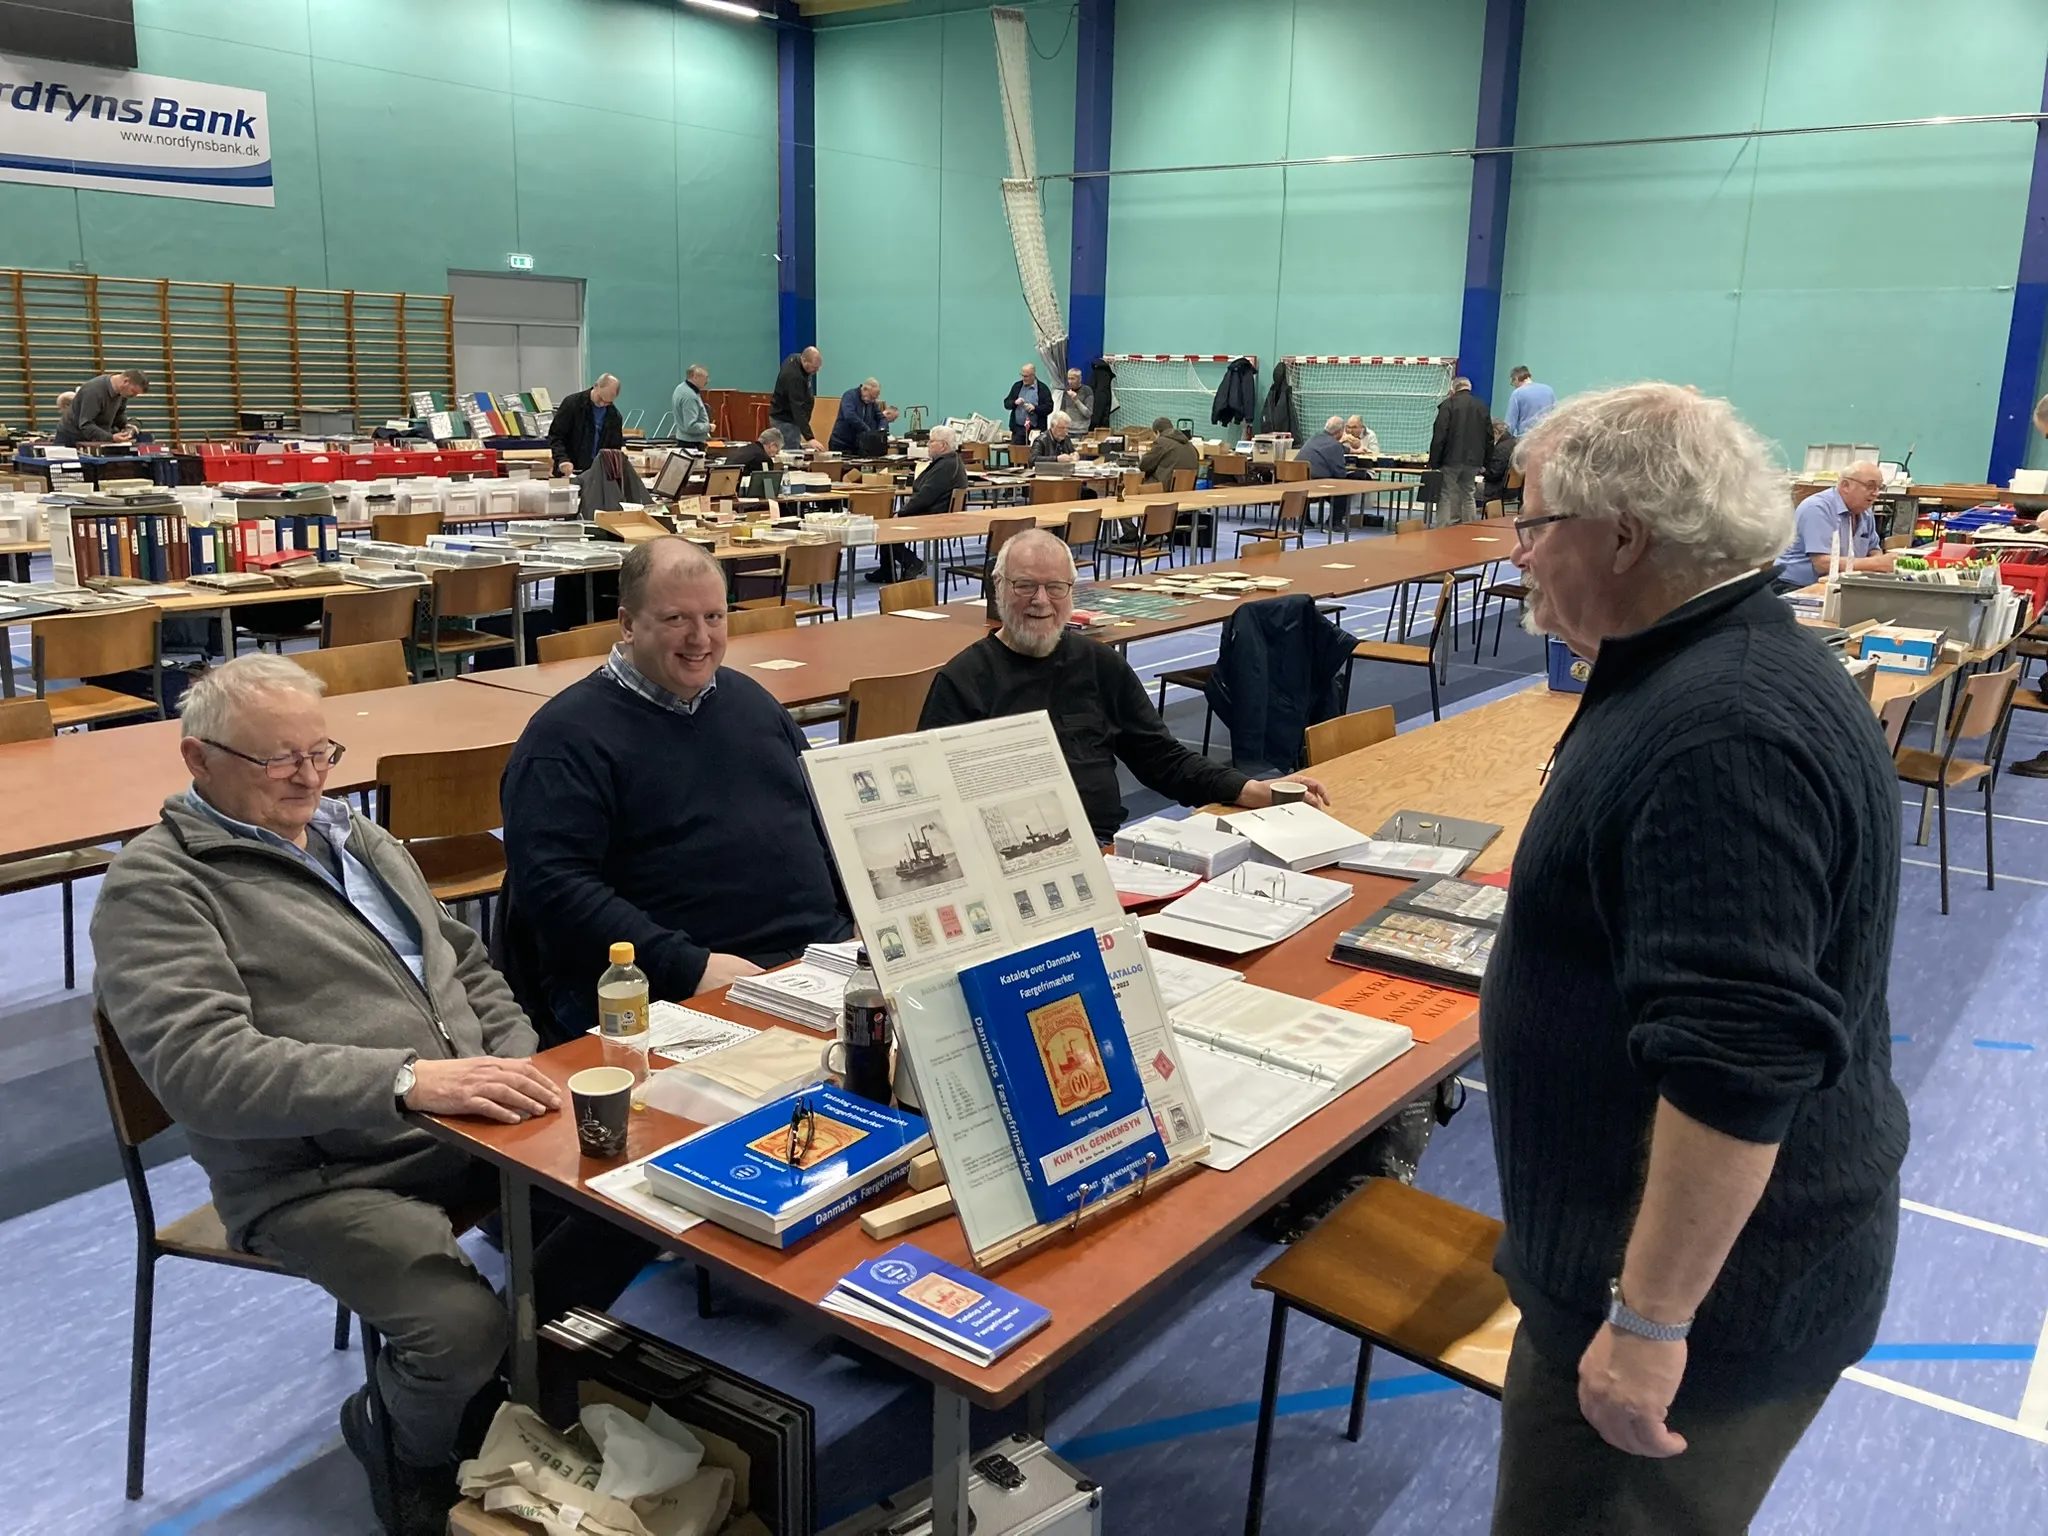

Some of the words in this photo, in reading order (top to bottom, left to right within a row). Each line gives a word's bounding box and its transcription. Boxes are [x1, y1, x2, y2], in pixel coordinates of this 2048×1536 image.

[120, 131, 260, 156] www.nordfynsbank.dk
[999, 967, 1030, 985] Katalog
[1030, 963, 1046, 975] over
[1045, 951, 1081, 969] Danmarks
[1019, 972, 1075, 999] Færgefrimærker
[1116, 980, 1130, 990] 2023
[1383, 990, 1405, 1002] OG
[1381, 987, 1444, 1024] BANEMÆR
[1422, 997, 1457, 1019] KLUB
[1071, 1073, 1089, 1094] 60
[822, 1092, 851, 1107] Katalog
[851, 1103, 870, 1114] over
[869, 1110, 909, 1127] Danmarks
[974, 1016, 999, 1079] Danmarks
[996, 1084, 1034, 1183] Færgefrimærker
[823, 1103, 885, 1129] Færgefrimærker
[1053, 1149, 1074, 1167] KUN
[1074, 1143, 1089, 1157] TIL
[1089, 1116, 1141, 1149] GENNEMSYN
[1066, 1189, 1082, 1202] DANS
[1108, 1157, 1147, 1180] BANEMÆRKEKLU
[815, 1195, 857, 1226] Danmarks
[860, 1163, 910, 1199] Færgefrimær
[956, 1308, 982, 1324] Katalog
[979, 1300, 993, 1310] over
[971, 1307, 1002, 1328] Danmarks
